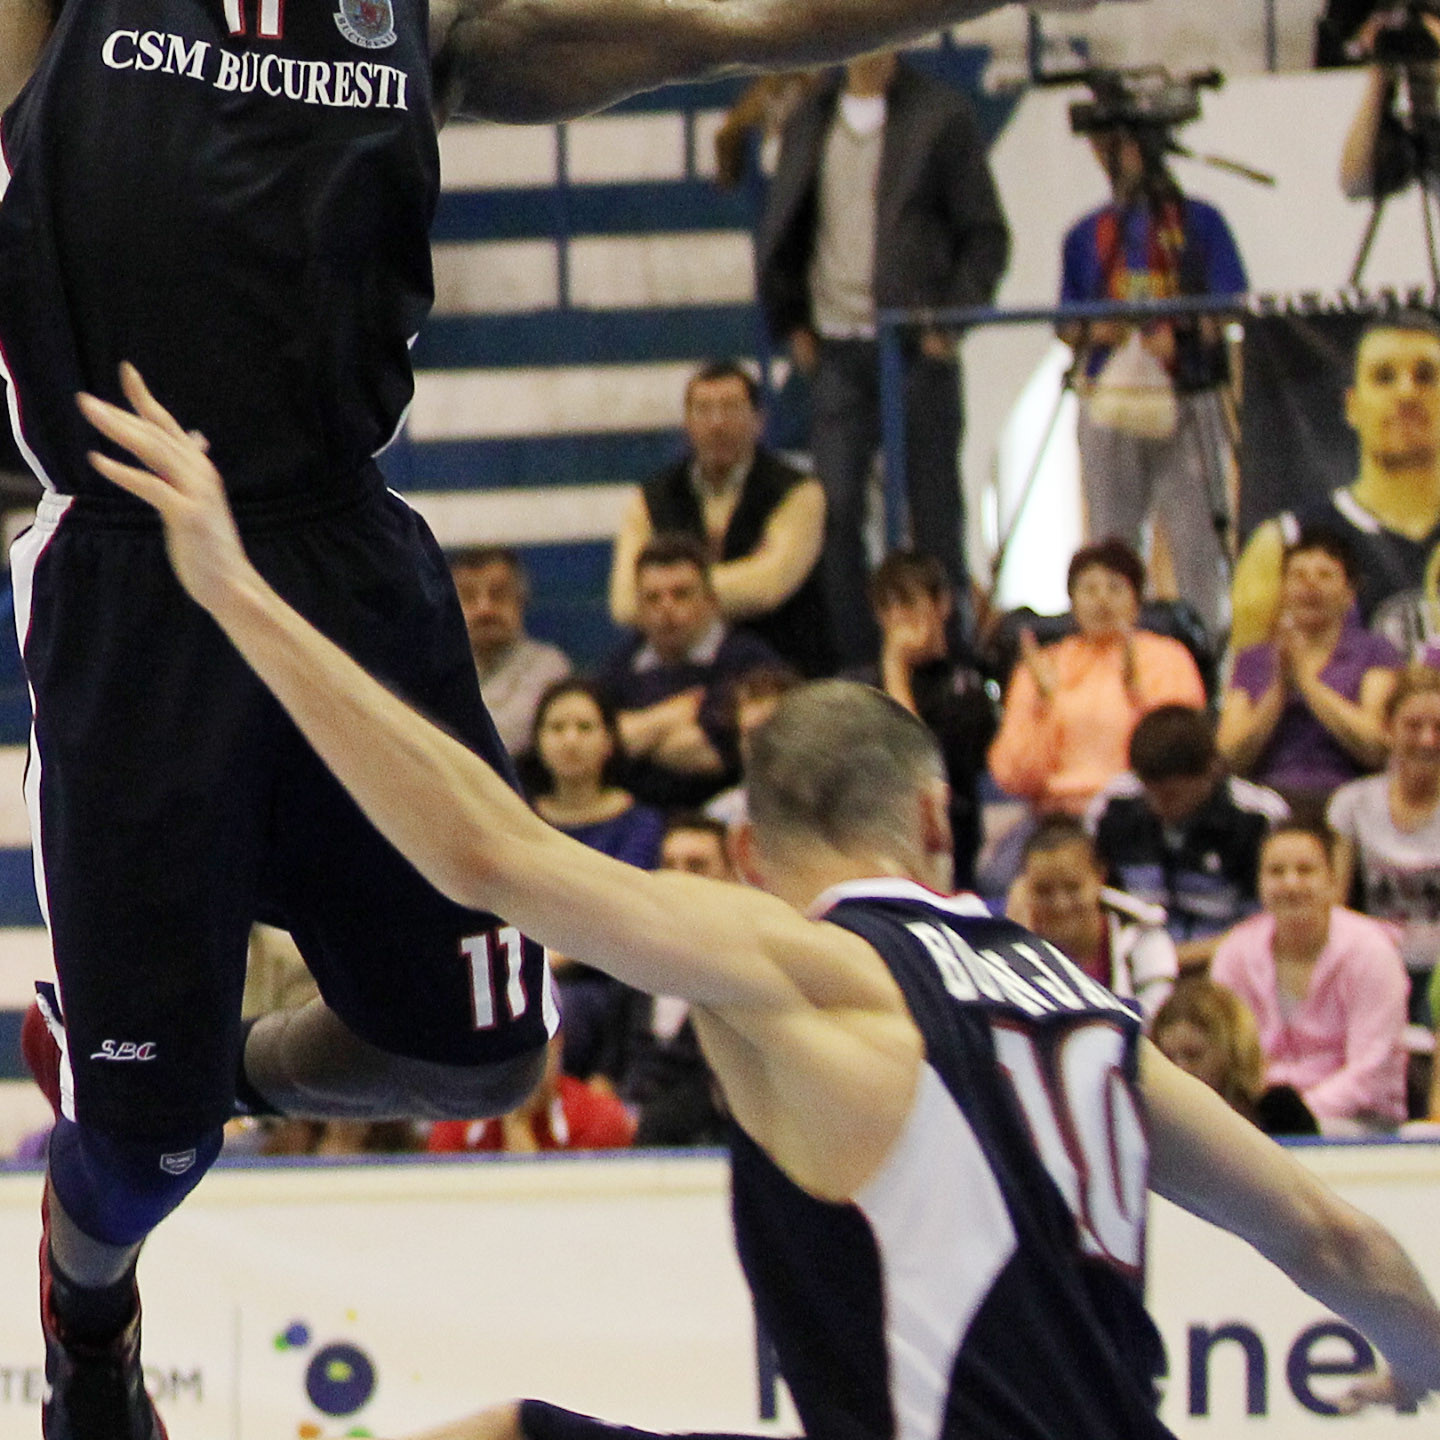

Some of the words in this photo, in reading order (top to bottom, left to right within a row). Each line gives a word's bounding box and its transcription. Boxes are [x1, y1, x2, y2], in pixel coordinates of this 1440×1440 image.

[101, 30, 211, 81] CSM
[214, 48, 409, 111] BUCURESTI
[460, 926, 527, 1031] 11
[990, 1016, 1145, 1274] 10
